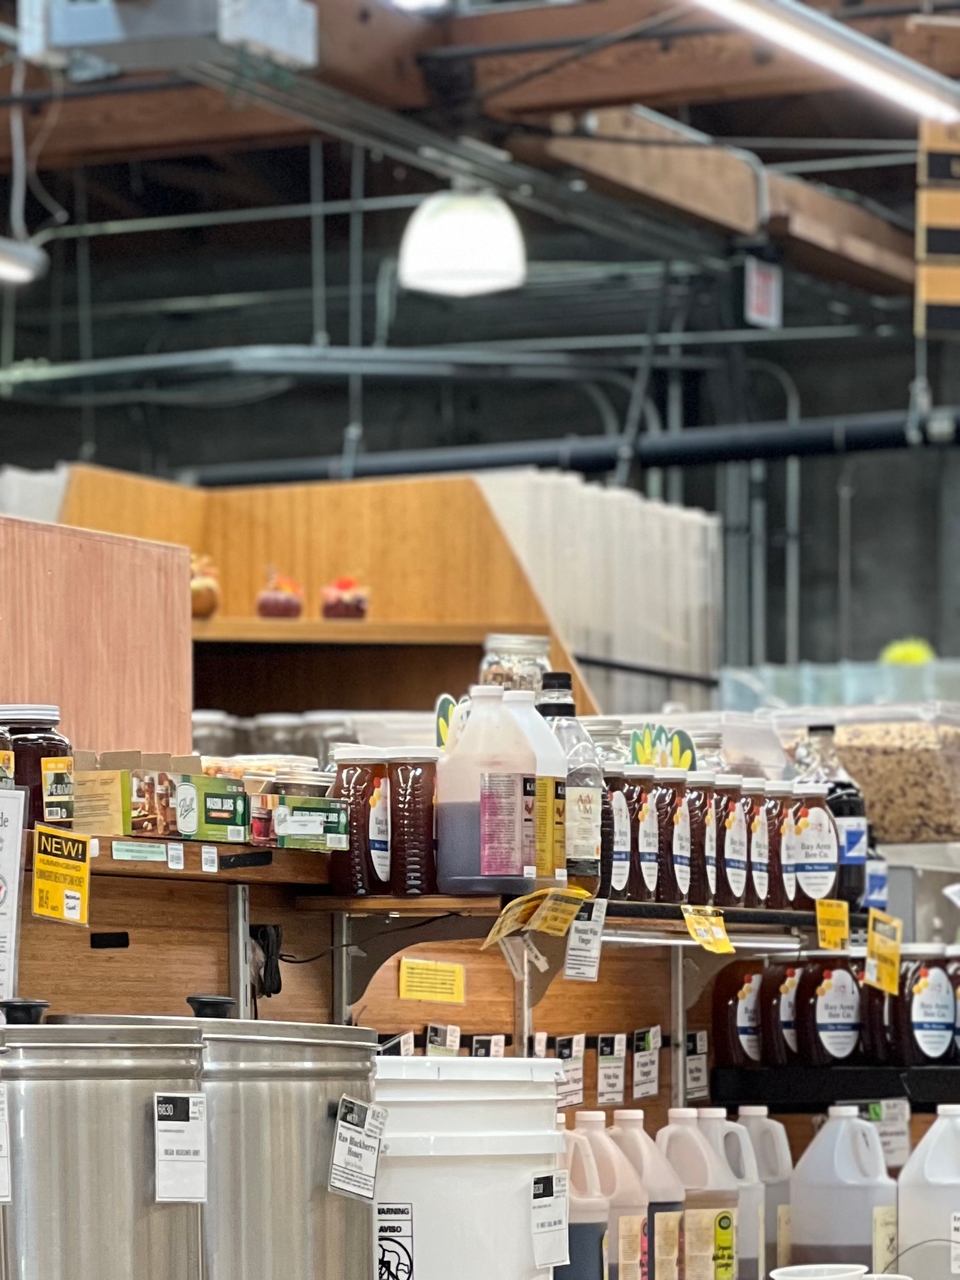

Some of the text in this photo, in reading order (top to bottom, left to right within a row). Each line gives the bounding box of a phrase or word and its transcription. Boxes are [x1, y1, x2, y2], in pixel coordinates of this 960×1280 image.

[41, 835, 83, 859] NEW!
[800, 842, 831, 852] Bay Area
[824, 1003, 837, 1012] Bay
[347, 1146, 363, 1162] Honey
[378, 1225, 402, 1233] AVISO
